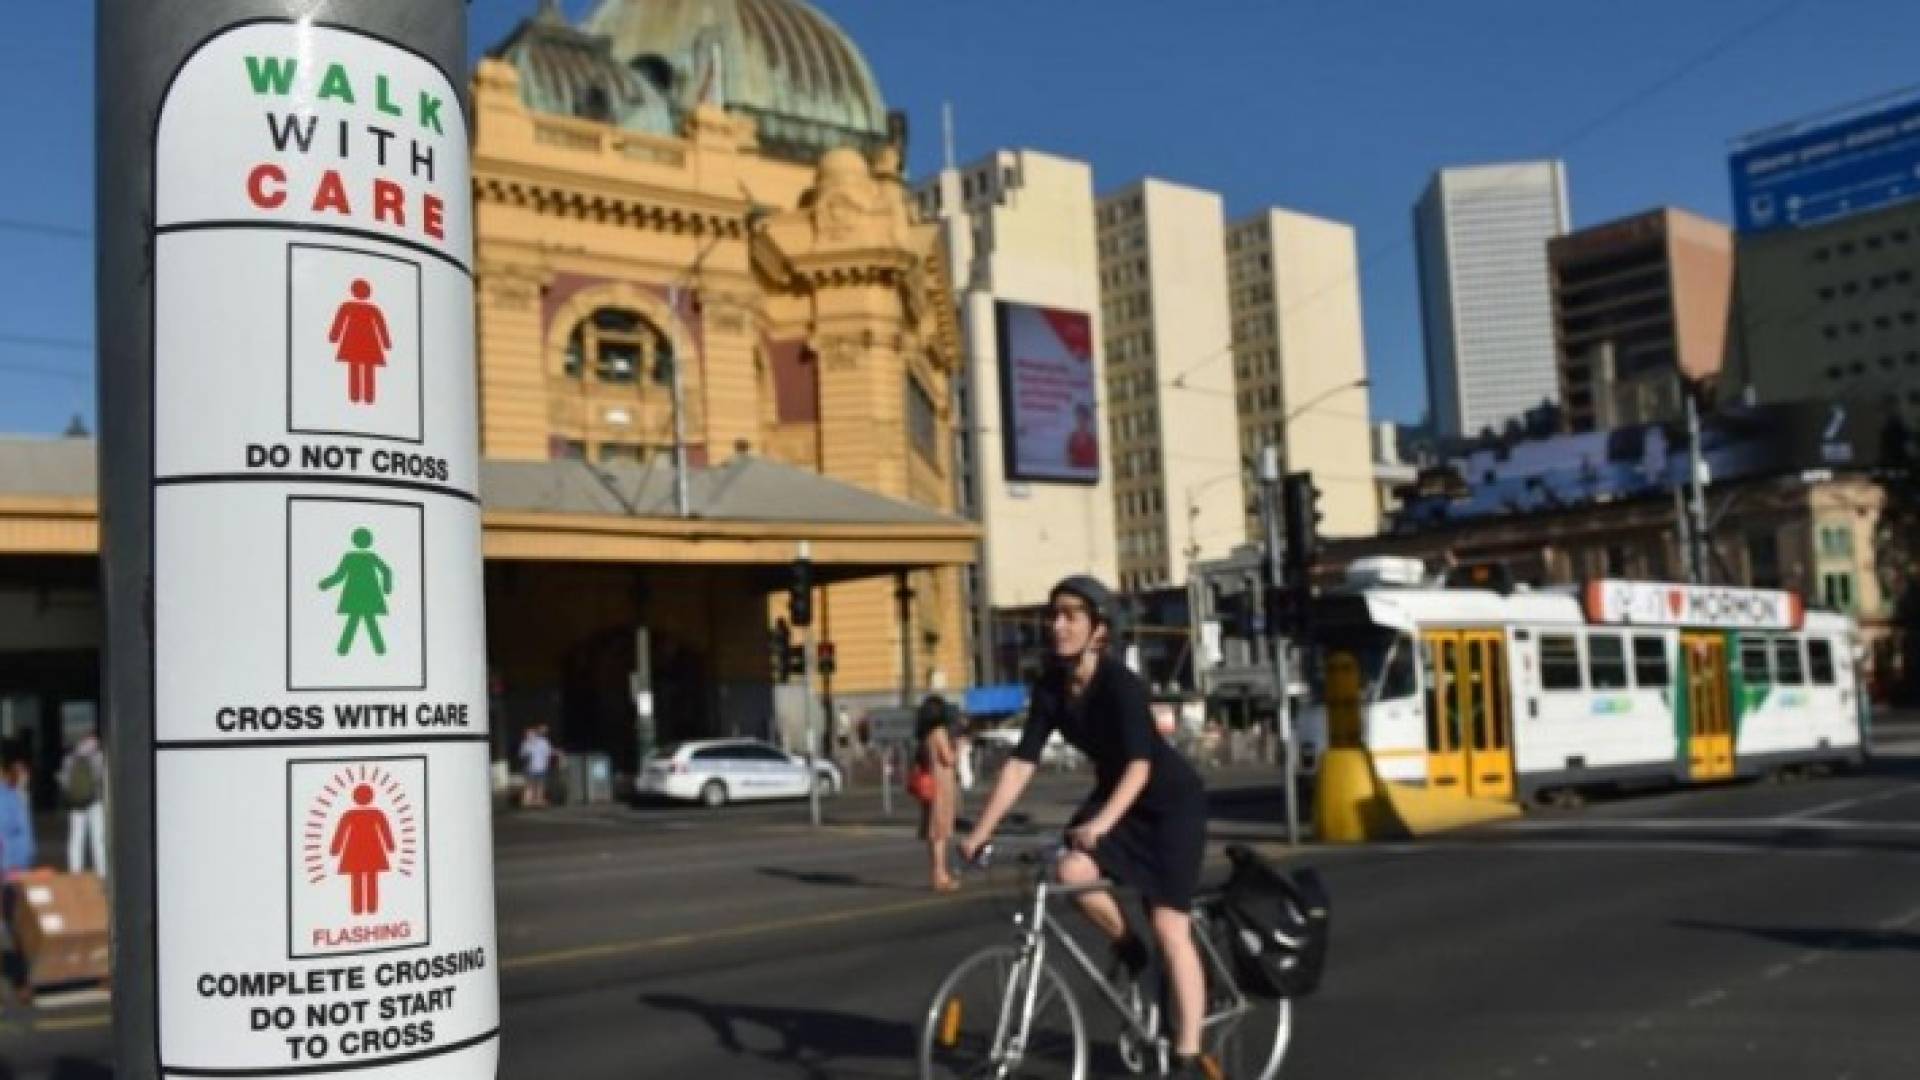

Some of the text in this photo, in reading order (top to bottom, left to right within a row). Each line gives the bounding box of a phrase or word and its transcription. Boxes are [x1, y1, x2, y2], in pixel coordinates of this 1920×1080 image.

[246, 56, 444, 136] WALK
[267, 112, 435, 182] WITH
[247, 163, 444, 240] CARE
[246, 445, 449, 482] DO NOT CROSS
[215, 703, 469, 733] CROSS WITH CARE
[312, 921, 411, 947] FLASHING
[197, 946, 485, 998] COMPLETE CROSSING
[250, 985, 457, 1032] DO NOT START
[285, 1020, 435, 1060] TO CROSS
